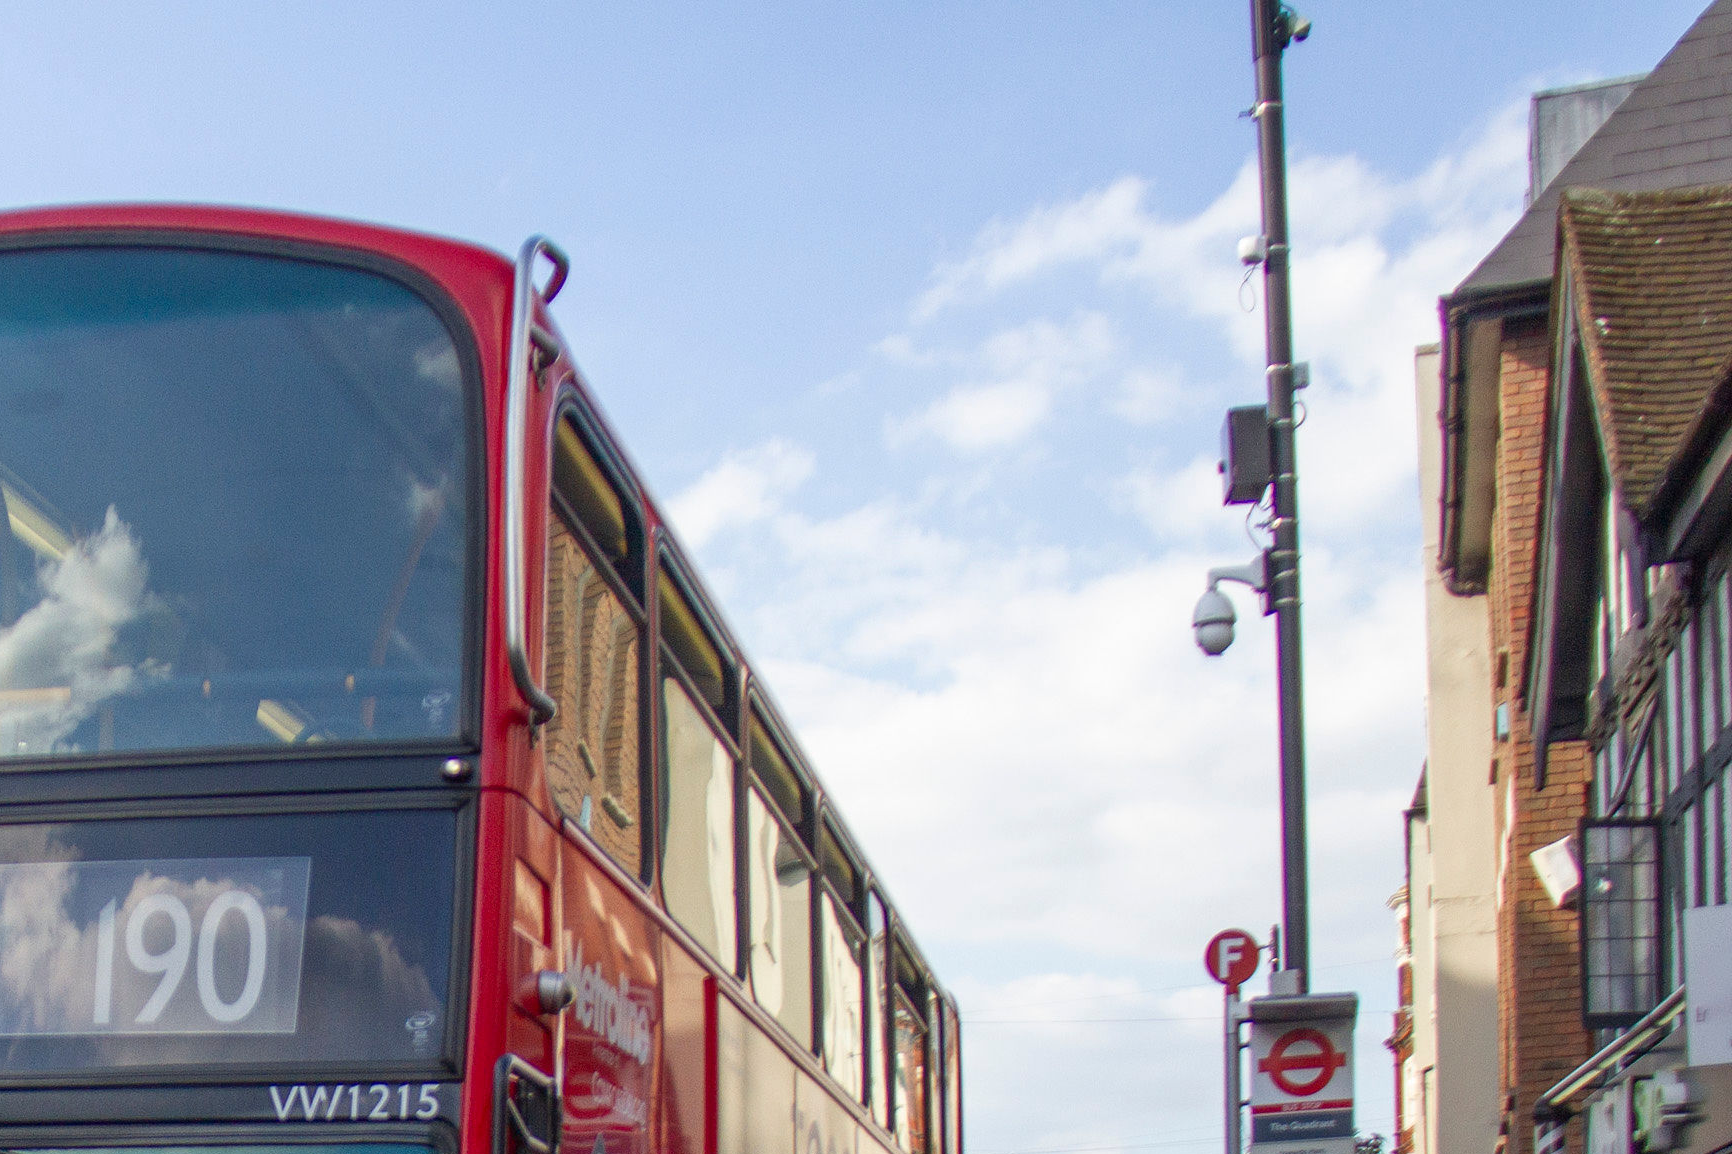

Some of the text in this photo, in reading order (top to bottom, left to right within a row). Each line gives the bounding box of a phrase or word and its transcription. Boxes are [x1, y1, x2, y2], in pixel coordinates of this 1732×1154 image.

[92, 890, 269, 1025] 190
[1218, 937, 1245, 979] F
[269, 1083, 439, 1120] VW1215
